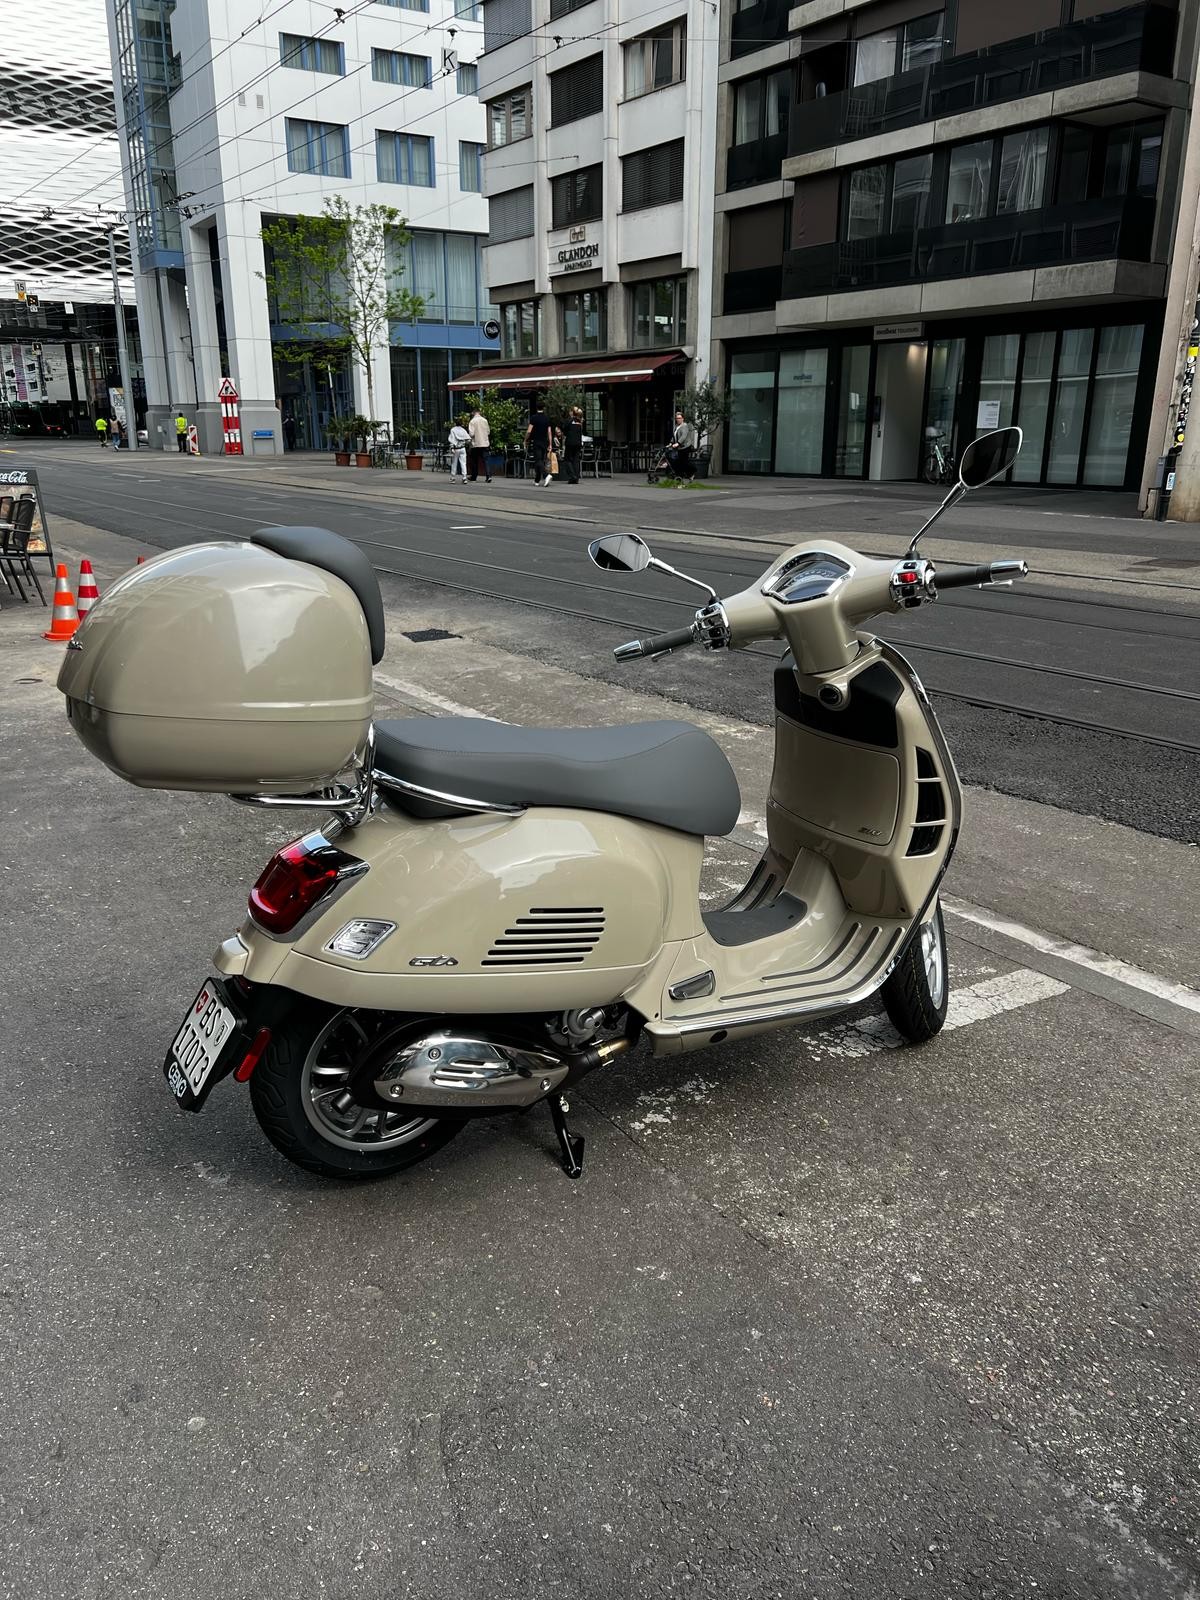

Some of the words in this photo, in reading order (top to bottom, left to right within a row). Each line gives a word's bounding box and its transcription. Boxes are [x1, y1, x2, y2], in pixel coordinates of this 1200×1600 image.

[443, 49, 455, 69] K
[557, 243, 599, 263] GLANDON
[16, 283, 25, 291] 15
[199, 997, 224, 1038] BS
[174, 1022, 210, 1089] 17073
